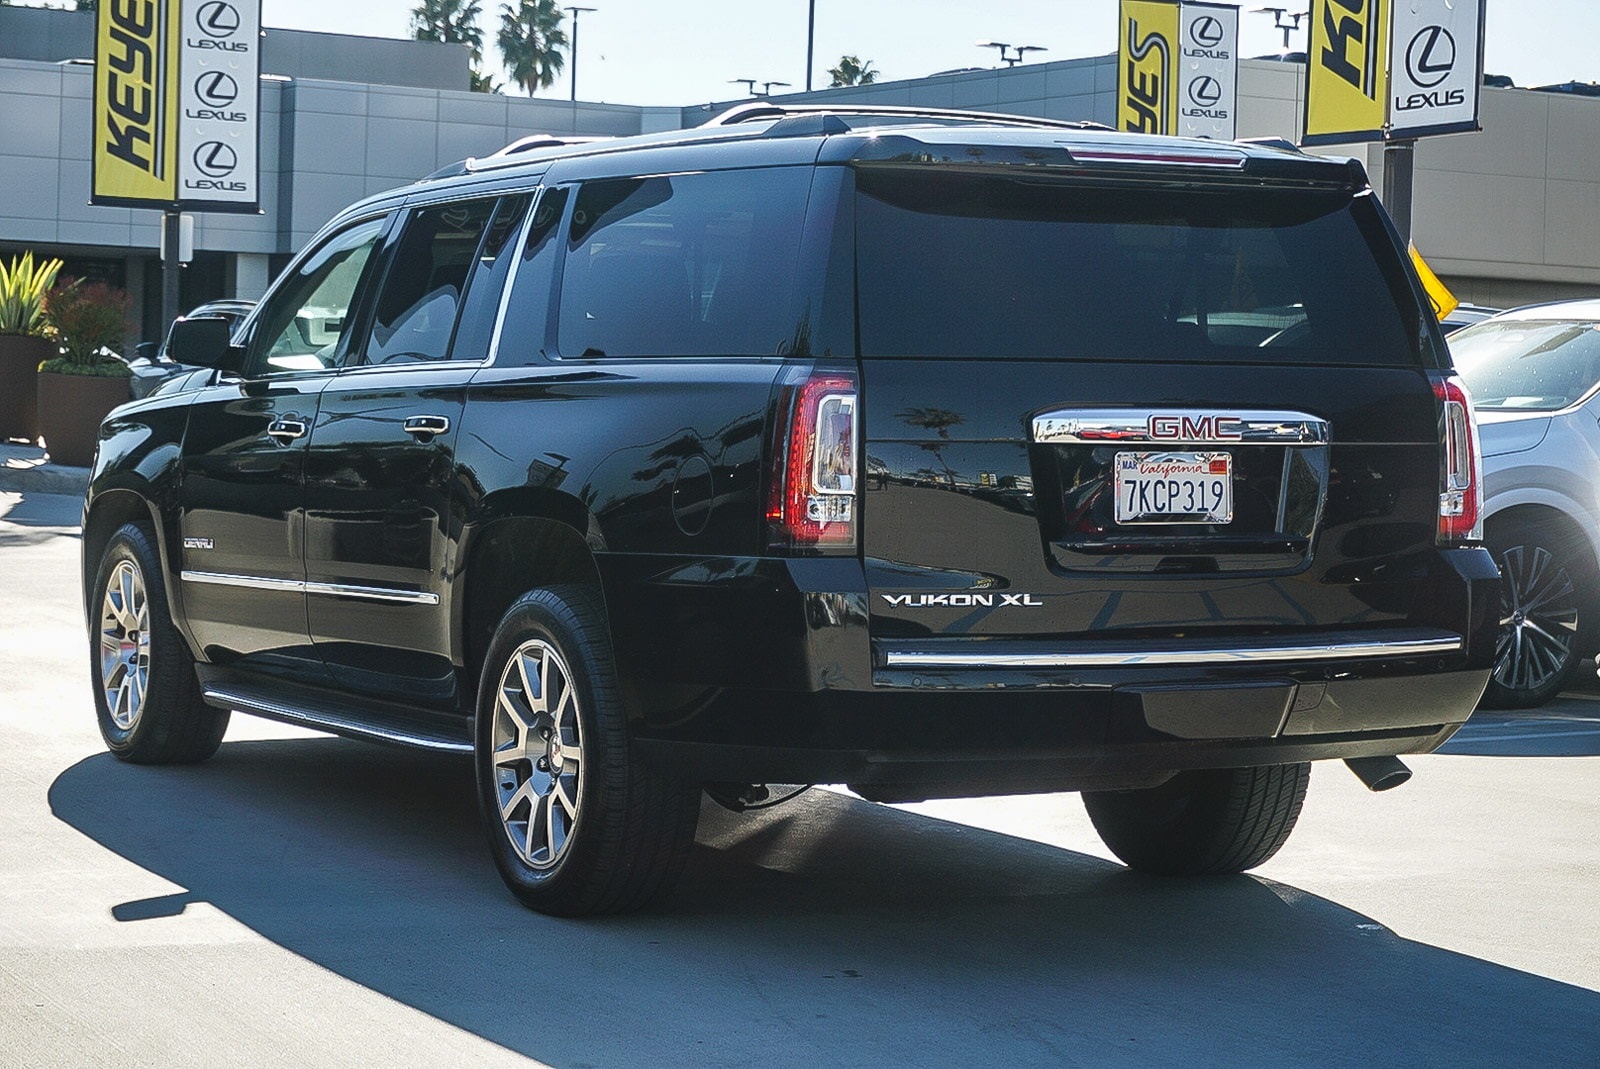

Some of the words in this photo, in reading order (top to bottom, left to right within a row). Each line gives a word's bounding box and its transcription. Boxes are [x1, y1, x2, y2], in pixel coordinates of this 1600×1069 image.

[187, 38, 248, 53] LEXUS
[1321, 0, 1364, 90] K
[1183, 47, 1229, 60] LEXUS
[1395, 88, 1466, 112] LEXUS
[185, 108, 247, 122] LEXUS
[1181, 107, 1228, 119] LEXUS
[184, 179, 247, 192] LEXUS
[1148, 415, 1243, 440] GMC
[1122, 460, 1138, 470] MAR
[1140, 463, 1210, 479] California
[1124, 479, 1224, 513] 7KCP319
[881, 594, 993, 607] YUKON
[998, 593, 1043, 607] XL
